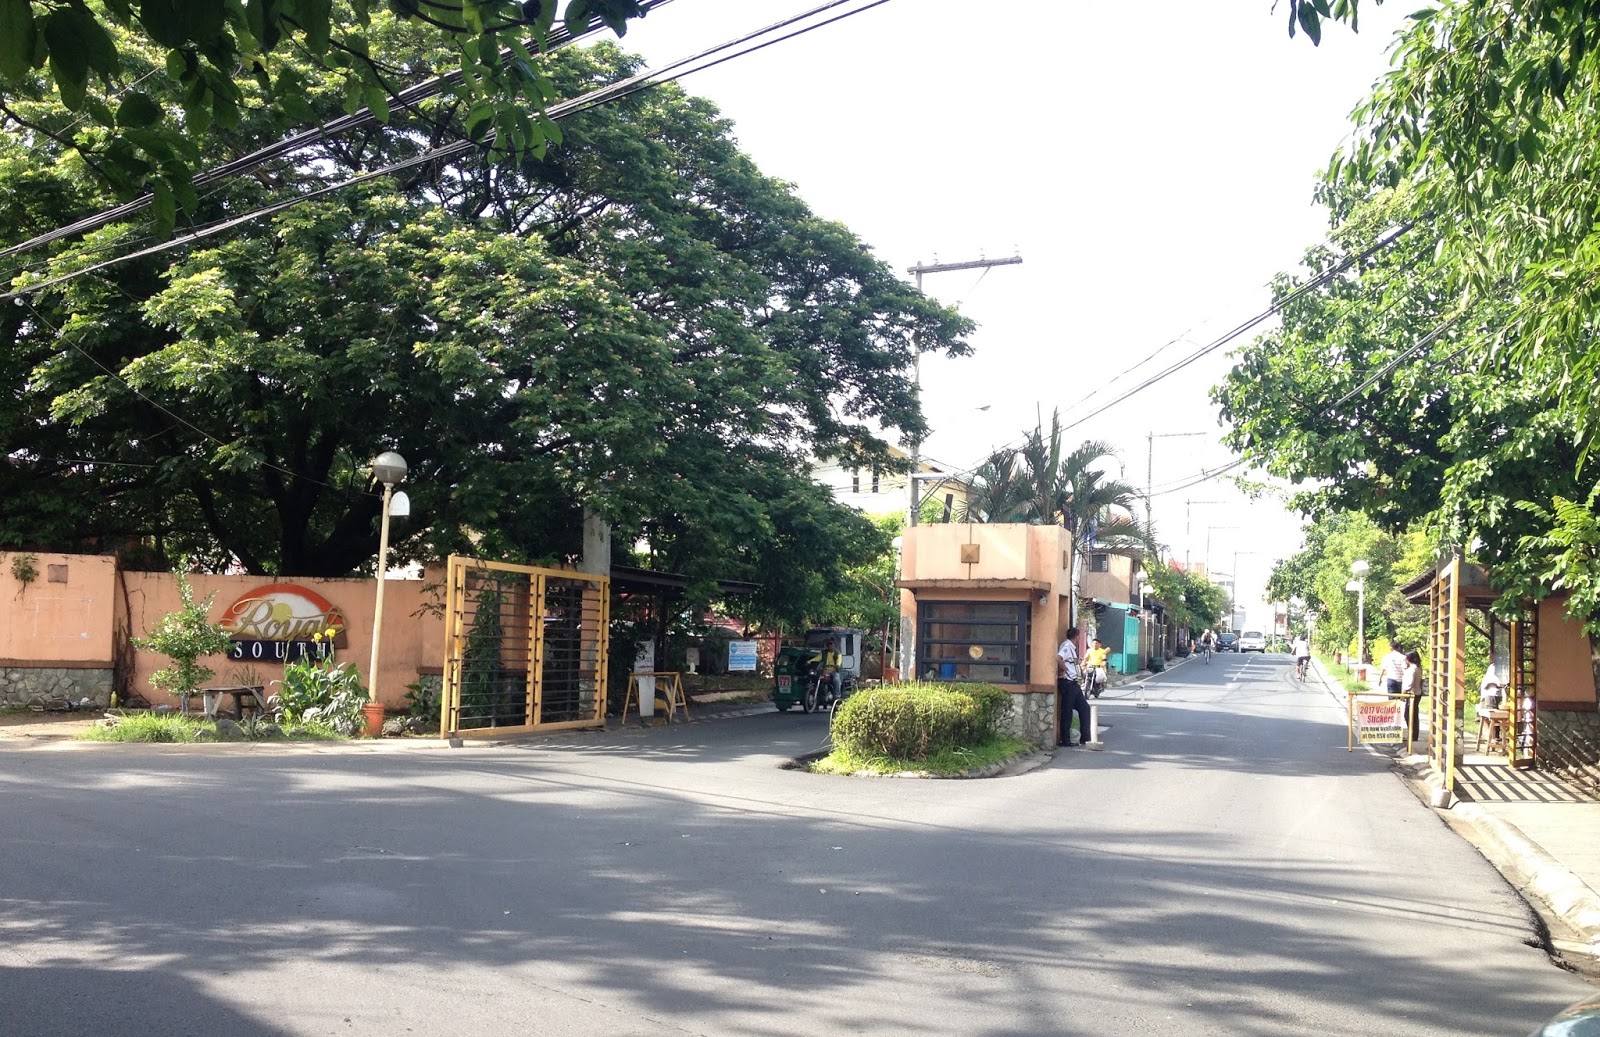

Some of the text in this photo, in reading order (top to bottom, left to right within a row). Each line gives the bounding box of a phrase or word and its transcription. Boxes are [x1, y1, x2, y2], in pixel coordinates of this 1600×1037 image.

[220, 597, 347, 641] Royal
[234, 641, 326, 659] SOUTH
[1360, 706, 1375, 714] 2017
[1367, 715, 1395, 724] Stickers
